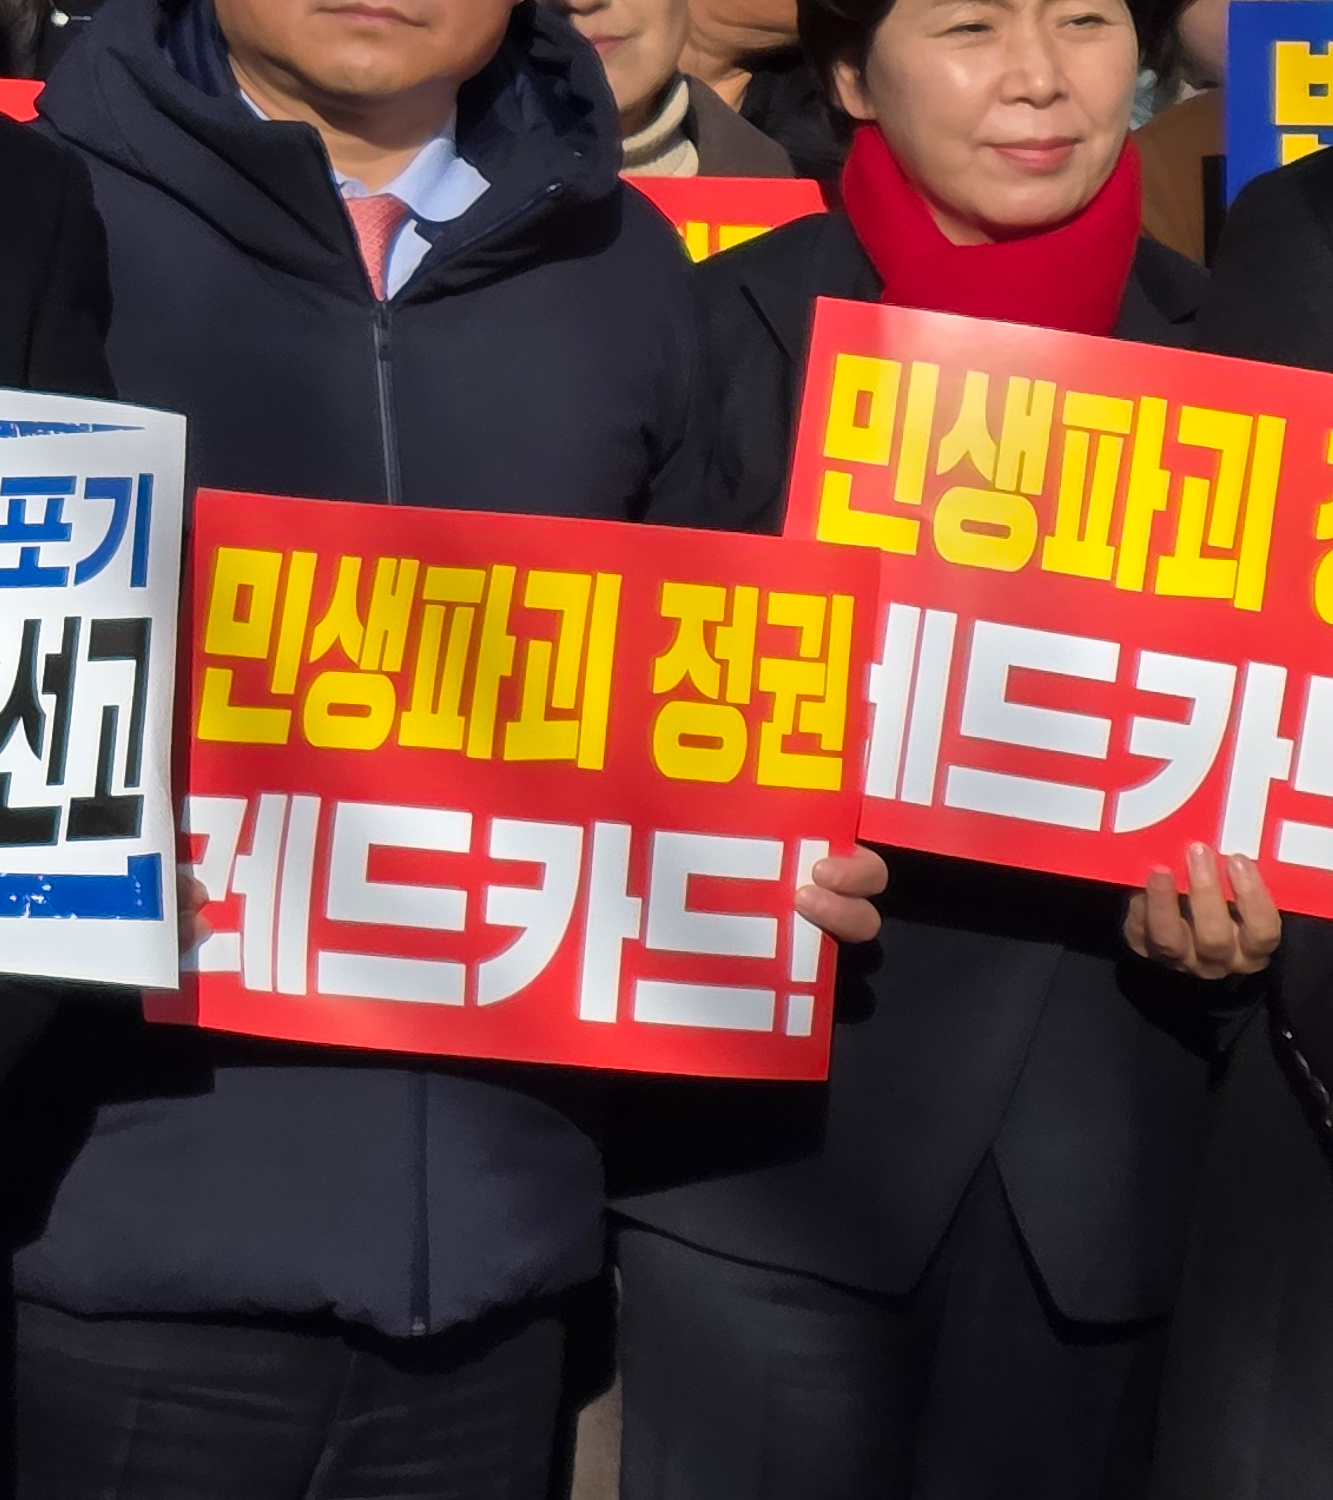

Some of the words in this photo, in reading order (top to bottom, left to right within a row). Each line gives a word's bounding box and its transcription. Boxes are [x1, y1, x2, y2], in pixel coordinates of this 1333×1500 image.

[817, 353, 1288, 612] 민생파괴
[197, 547, 623, 771] 민생파괴
[653, 581, 855, 791] 정권
